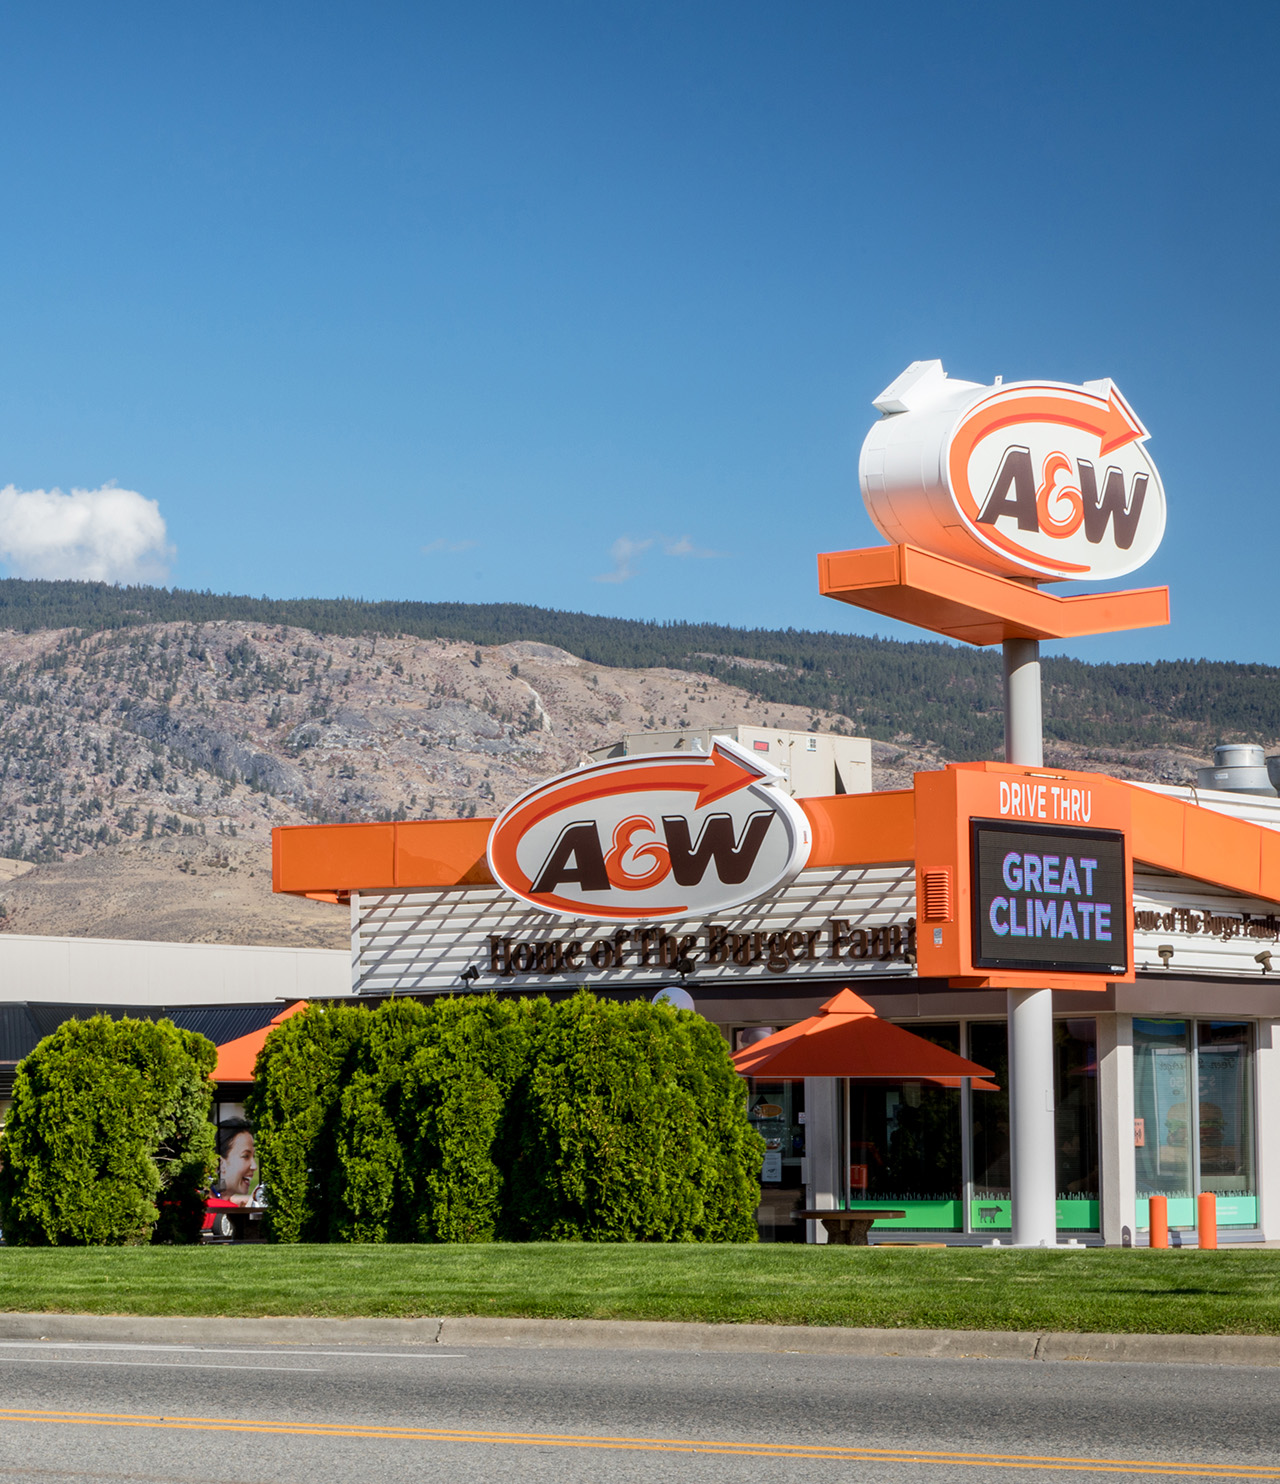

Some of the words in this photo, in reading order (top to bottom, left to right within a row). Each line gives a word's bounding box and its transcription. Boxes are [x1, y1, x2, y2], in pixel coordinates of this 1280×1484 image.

[975, 444, 1149, 550] A&W
[999, 781, 1047, 819] DRIVE
[1051, 787, 1092, 823] THRU
[530, 809, 776, 893] A&W
[1002, 852, 1098, 896] GREAT
[989, 896, 1113, 942] CLIMATE
[486, 934, 584, 977] Home
[590, 928, 630, 969] of
[634, 927, 699, 970] The
[704, 924, 821, 974] Burger
